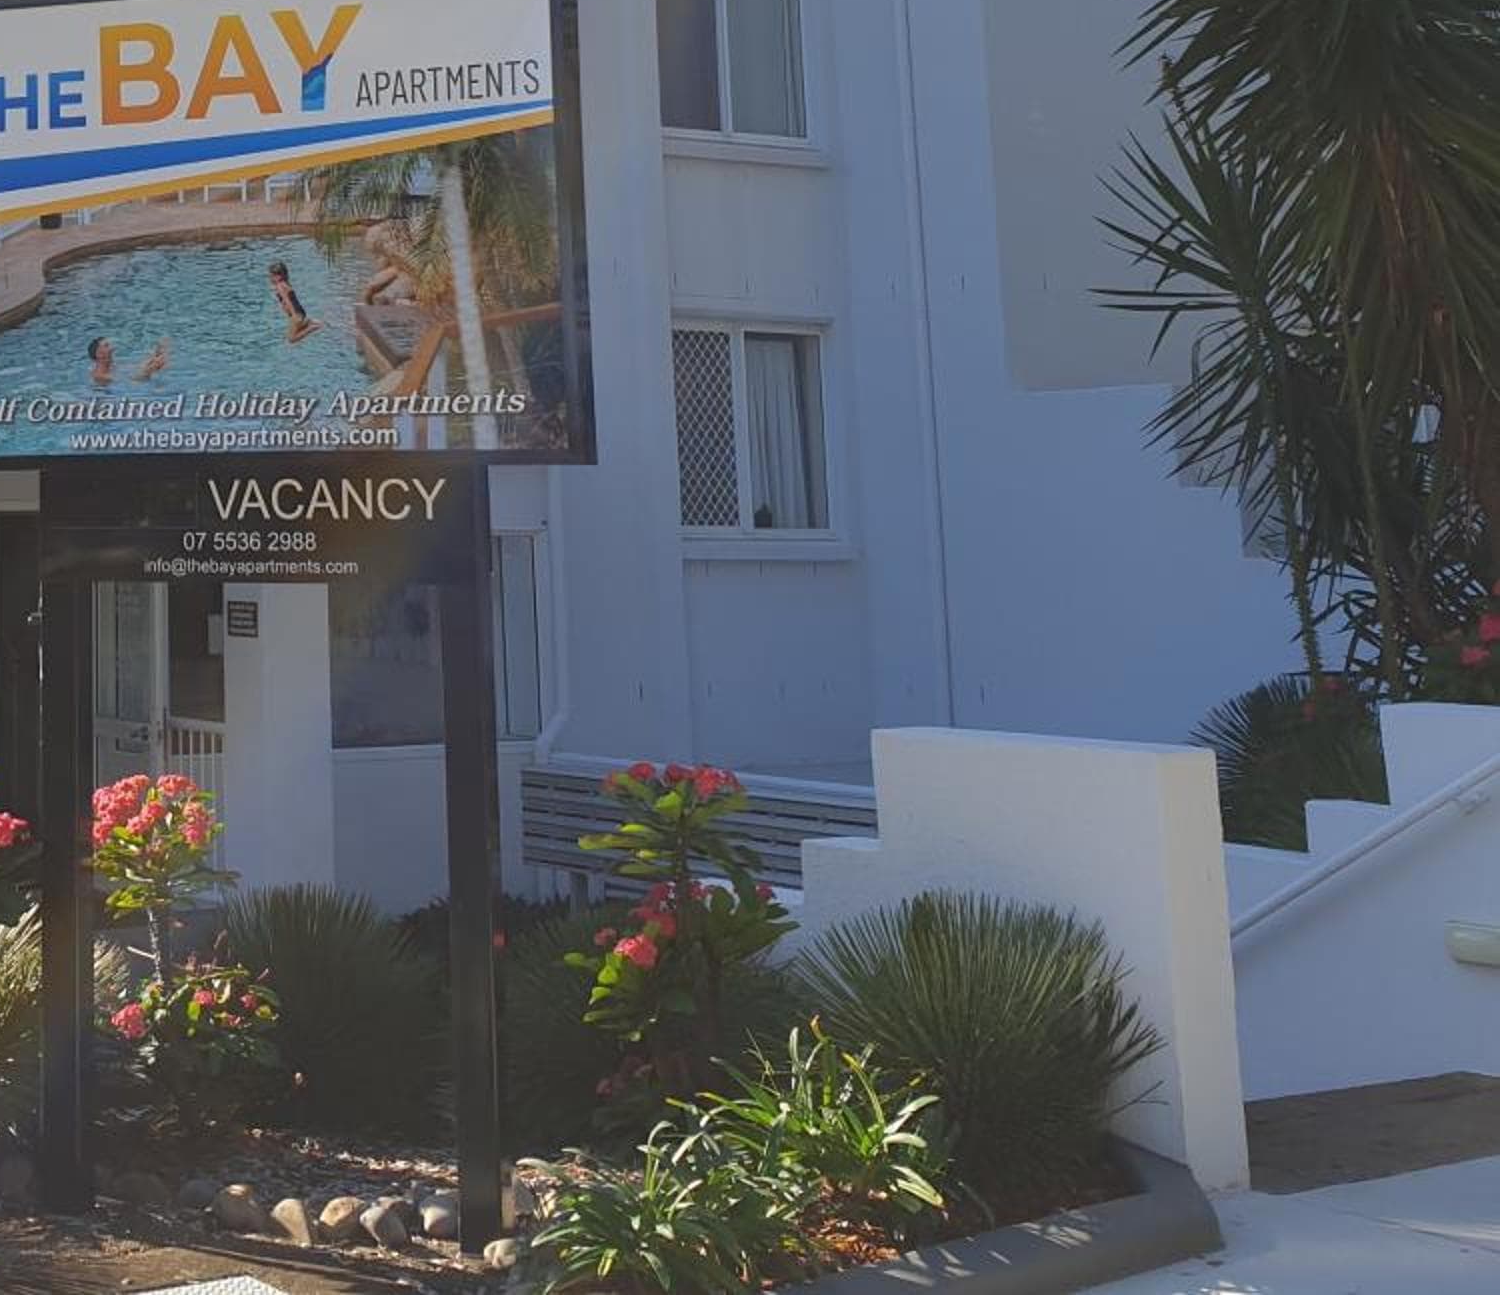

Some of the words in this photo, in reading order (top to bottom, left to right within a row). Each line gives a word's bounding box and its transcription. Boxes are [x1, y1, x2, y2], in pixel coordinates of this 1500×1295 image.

[99, 3, 363, 126] BAY
[355, 59, 540, 108] APARTMENTS
[26, 393, 184, 423] Contained
[194, 391, 316, 423] Holiday
[325, 388, 527, 422] Apartments
[69, 426, 399, 452] www.thebayapartments.com
[207, 478, 447, 521] VACANCY
[182, 532, 207, 551] 07
[212, 532, 262, 551] 5536
[267, 532, 318, 551] 2988
[144, 557, 359, 577] info@thebayapartments.com
